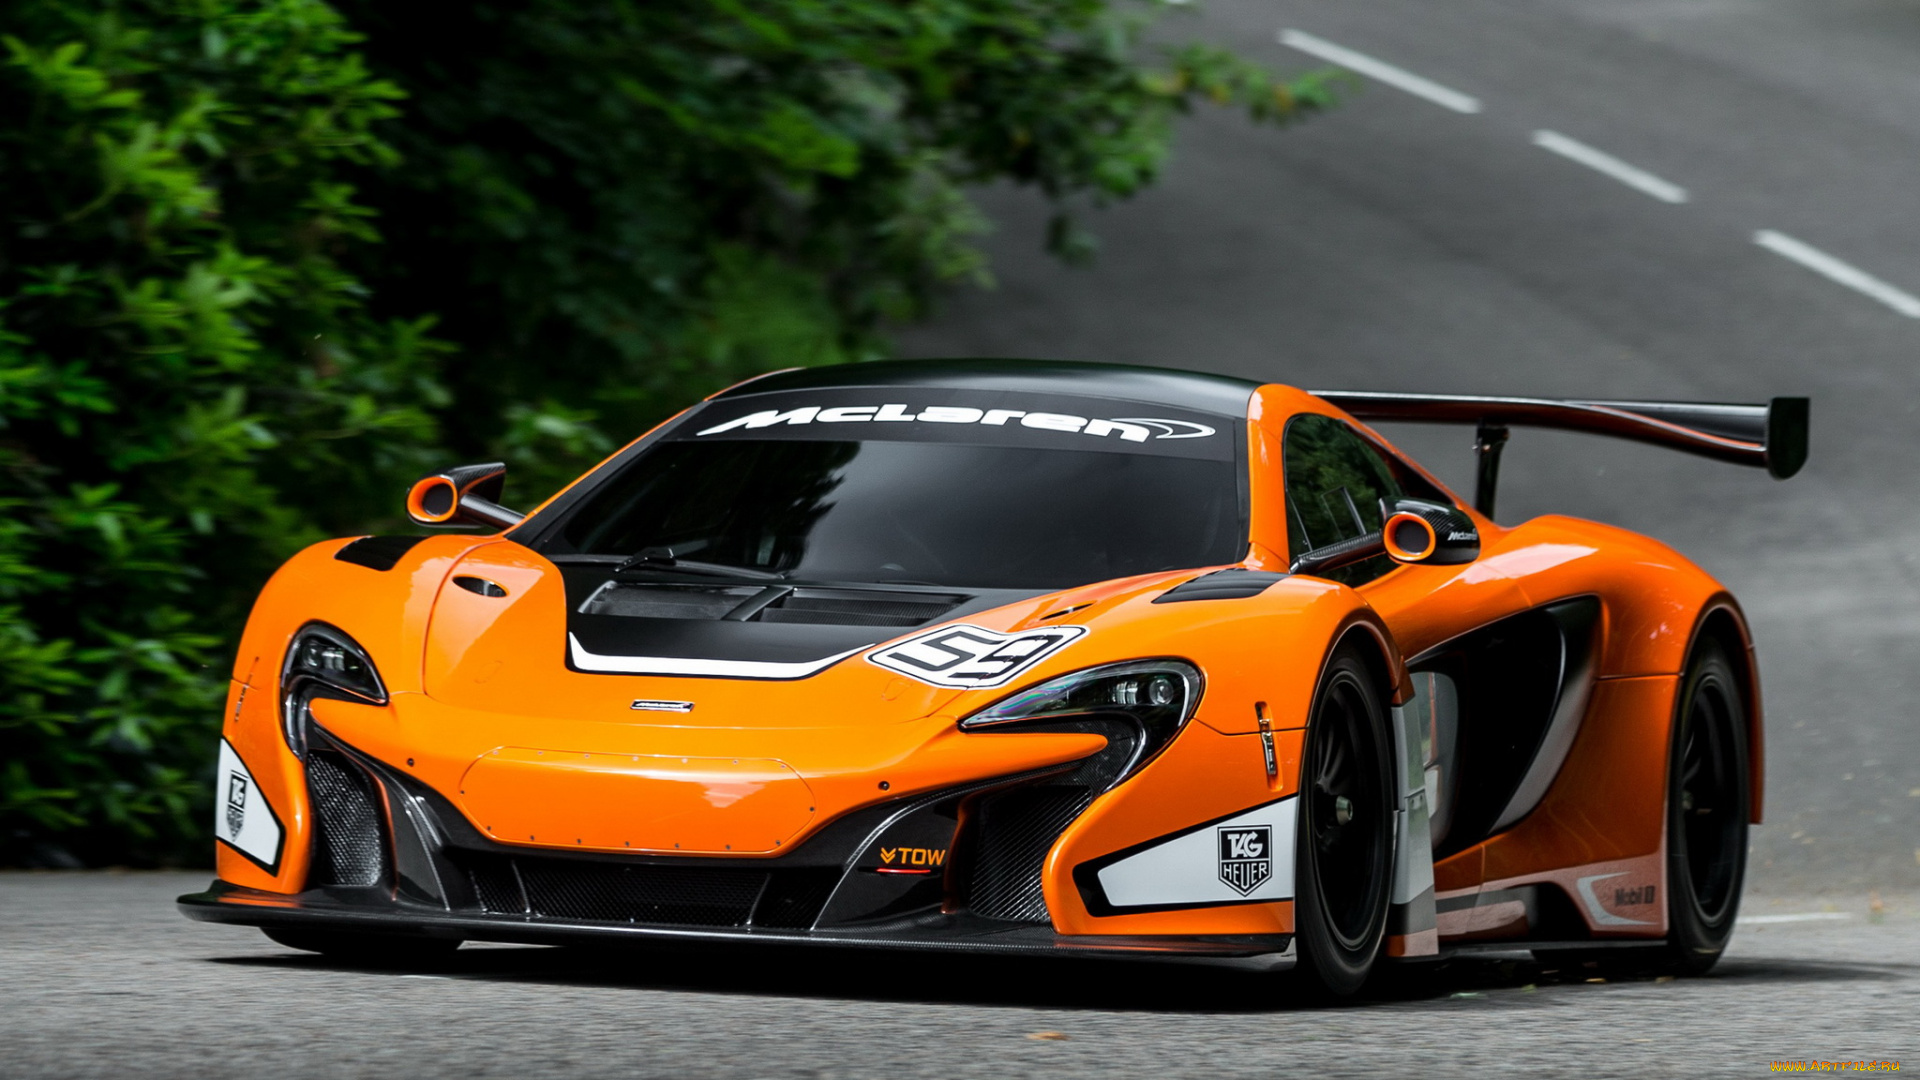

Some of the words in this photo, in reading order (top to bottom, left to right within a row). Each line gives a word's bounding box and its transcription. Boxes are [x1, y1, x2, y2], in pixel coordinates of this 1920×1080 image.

[696, 403, 1150, 443] McLaren
[886, 630, 1064, 679] 59
[898, 847, 946, 866] TOW
[1227, 831, 1263, 858] TAG
[1223, 862, 1268, 890] HEUER
